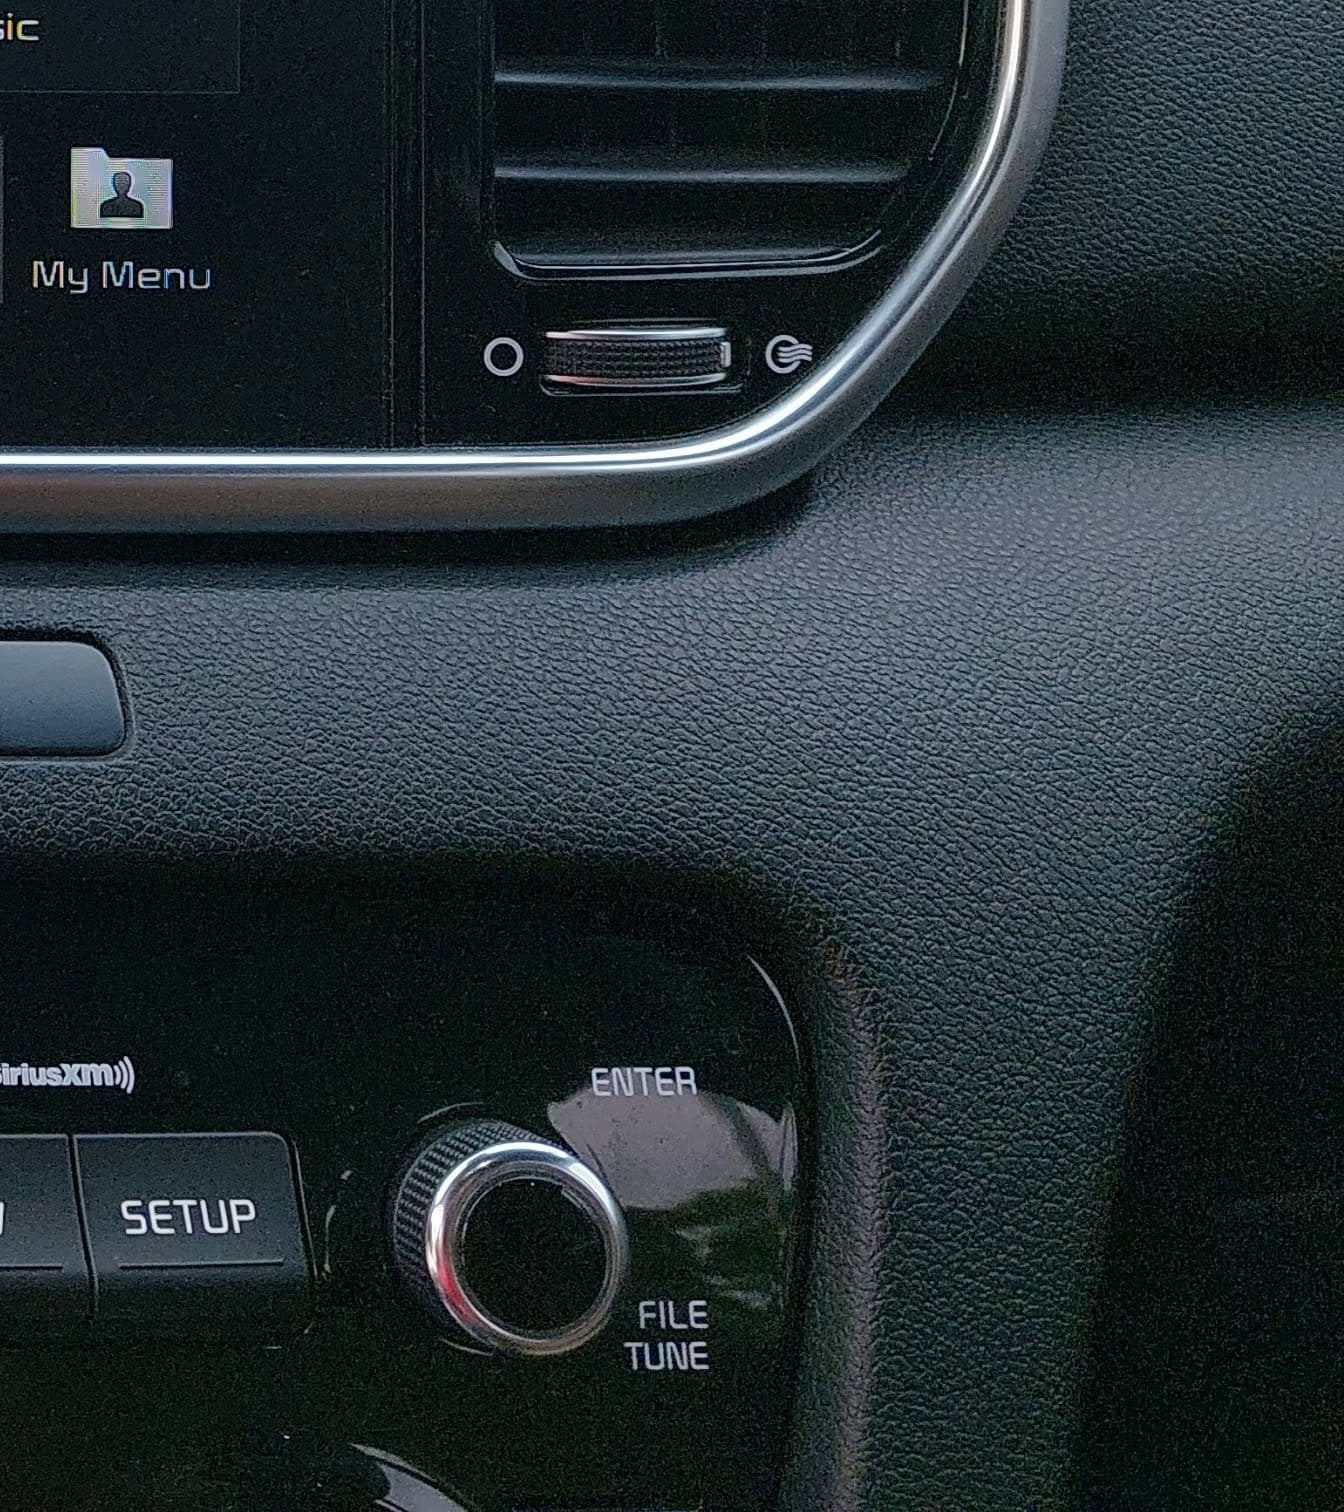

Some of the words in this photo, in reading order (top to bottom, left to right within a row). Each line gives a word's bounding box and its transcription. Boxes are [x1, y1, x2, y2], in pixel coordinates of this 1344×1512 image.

[32, 260, 89, 294] My
[102, 260, 211, 290] Menu
[590, 1065, 697, 1097] ENTER
[120, 1199, 256, 1235] SETUP
[638, 1299, 709, 1330] FILE
[623, 1341, 710, 1371] TUNE
